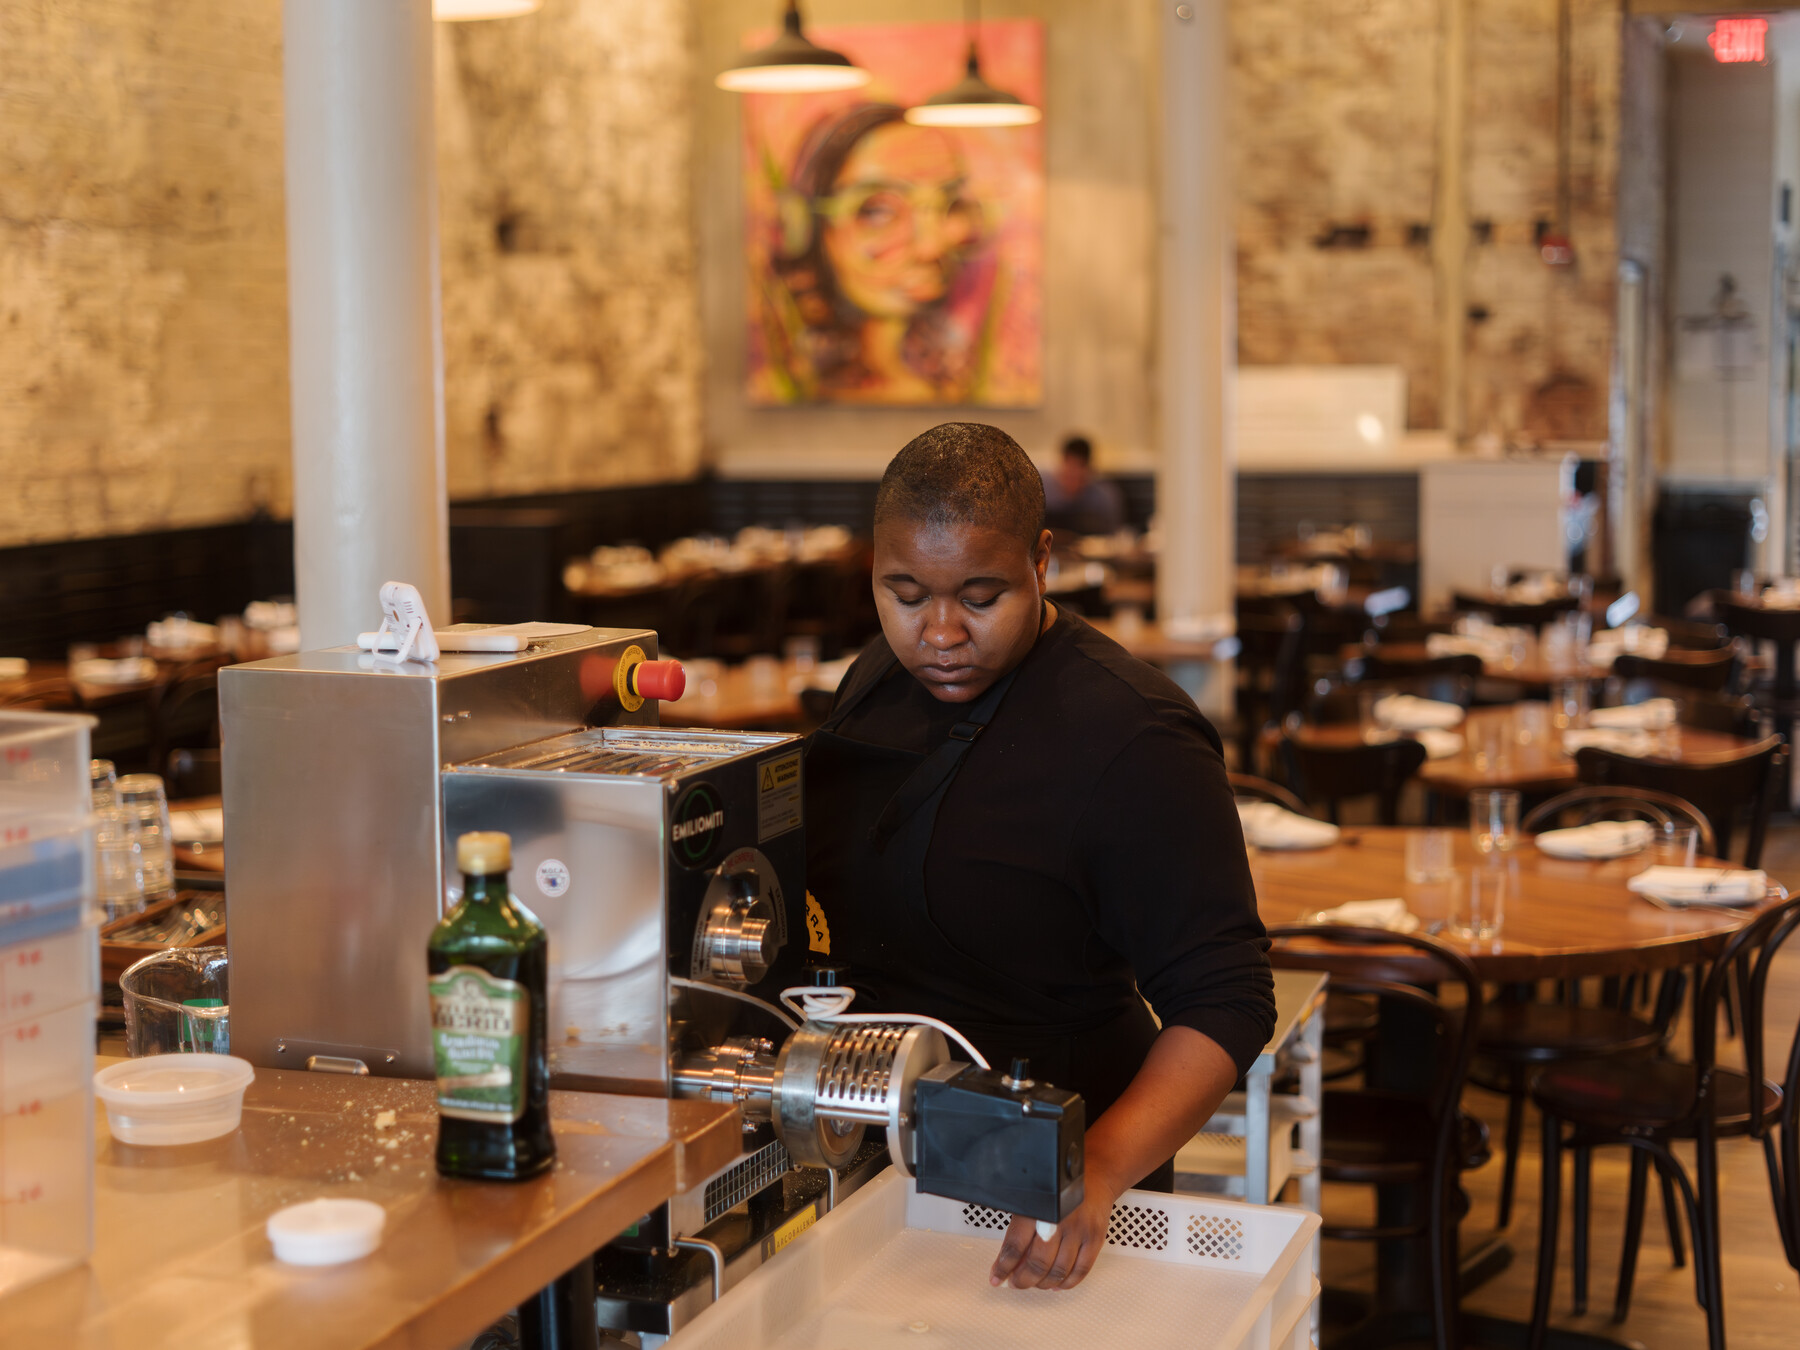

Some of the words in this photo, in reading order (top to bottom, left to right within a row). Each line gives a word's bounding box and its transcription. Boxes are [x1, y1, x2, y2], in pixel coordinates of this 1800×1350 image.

[1715, 18, 1768, 63] EXIT
[672, 810, 724, 842] EMILIOMITI
[776, 1215, 815, 1248] ARCOBALENO
